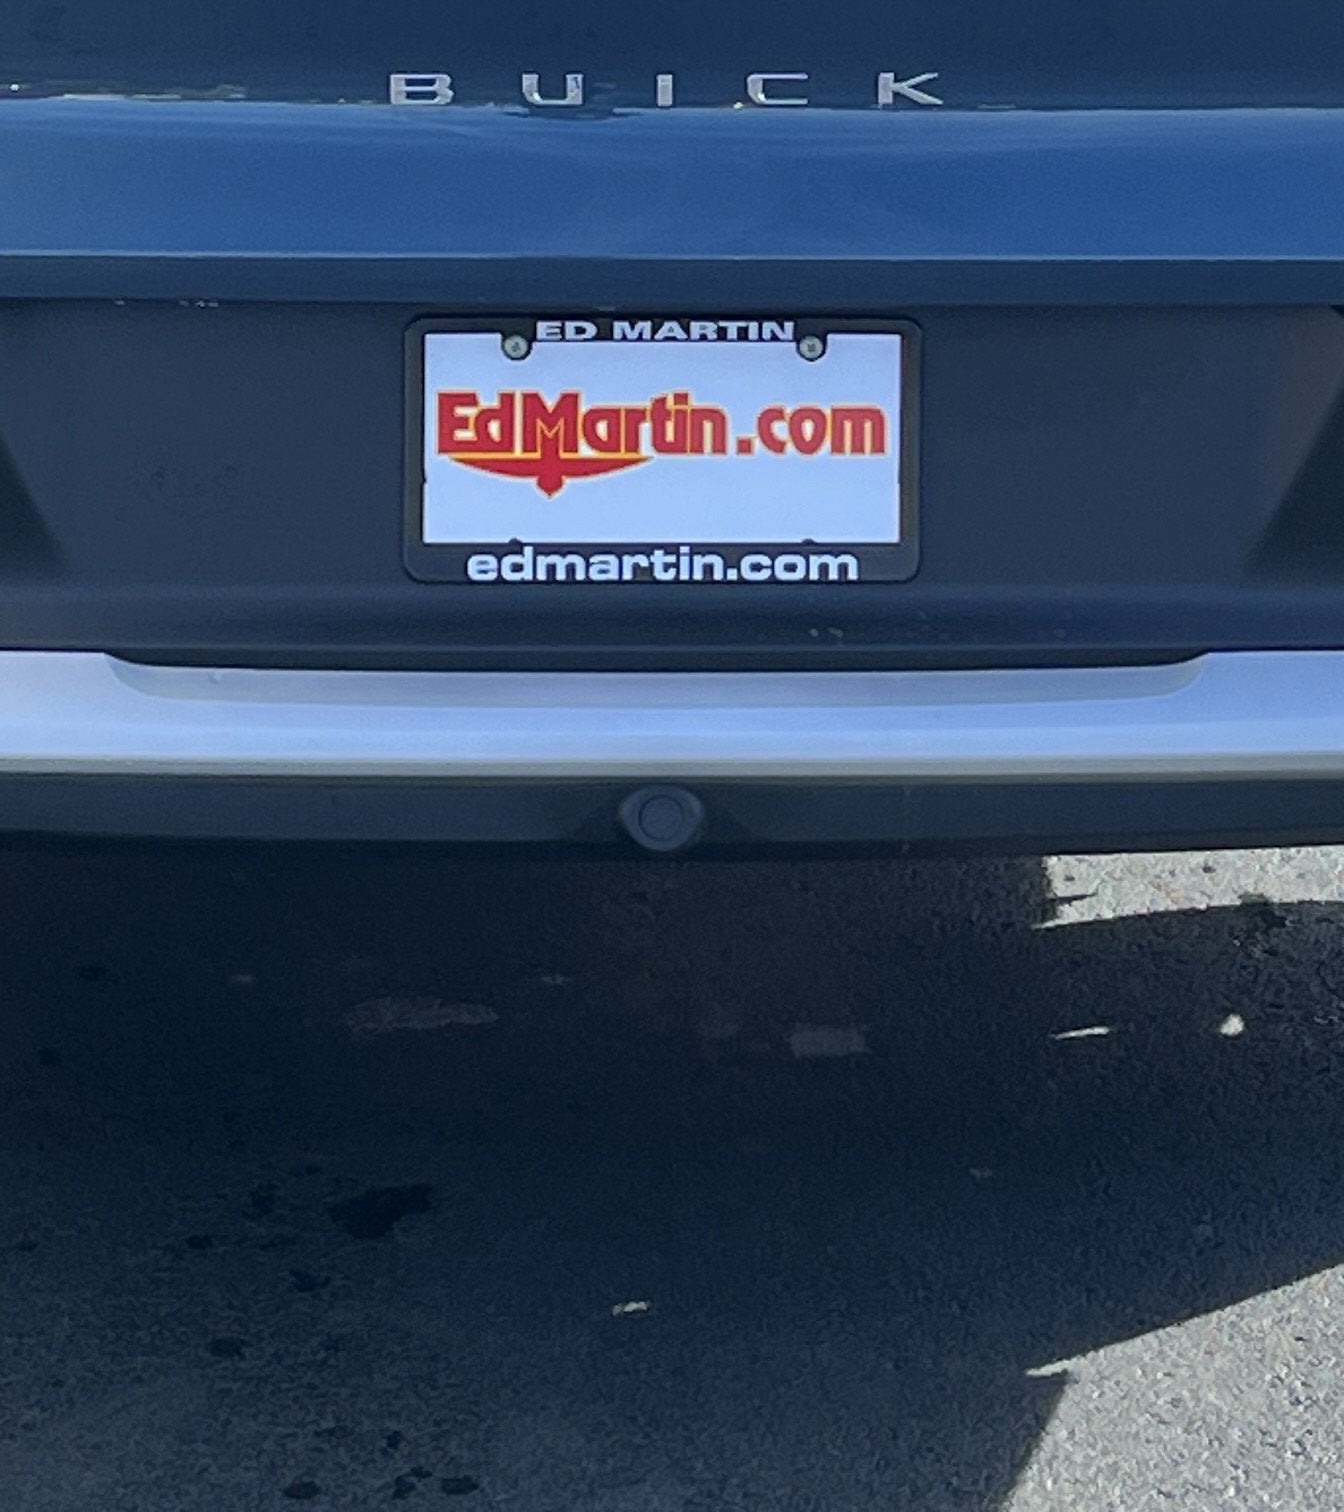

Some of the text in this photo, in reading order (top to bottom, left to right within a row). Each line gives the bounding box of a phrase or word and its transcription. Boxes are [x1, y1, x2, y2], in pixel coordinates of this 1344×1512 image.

[389, 71, 944, 108] BUICK
[535, 320, 796, 342] ED MARTIN
[435, 390, 888, 458] EdMartin.com
[466, 545, 859, 582] edmartin.com
